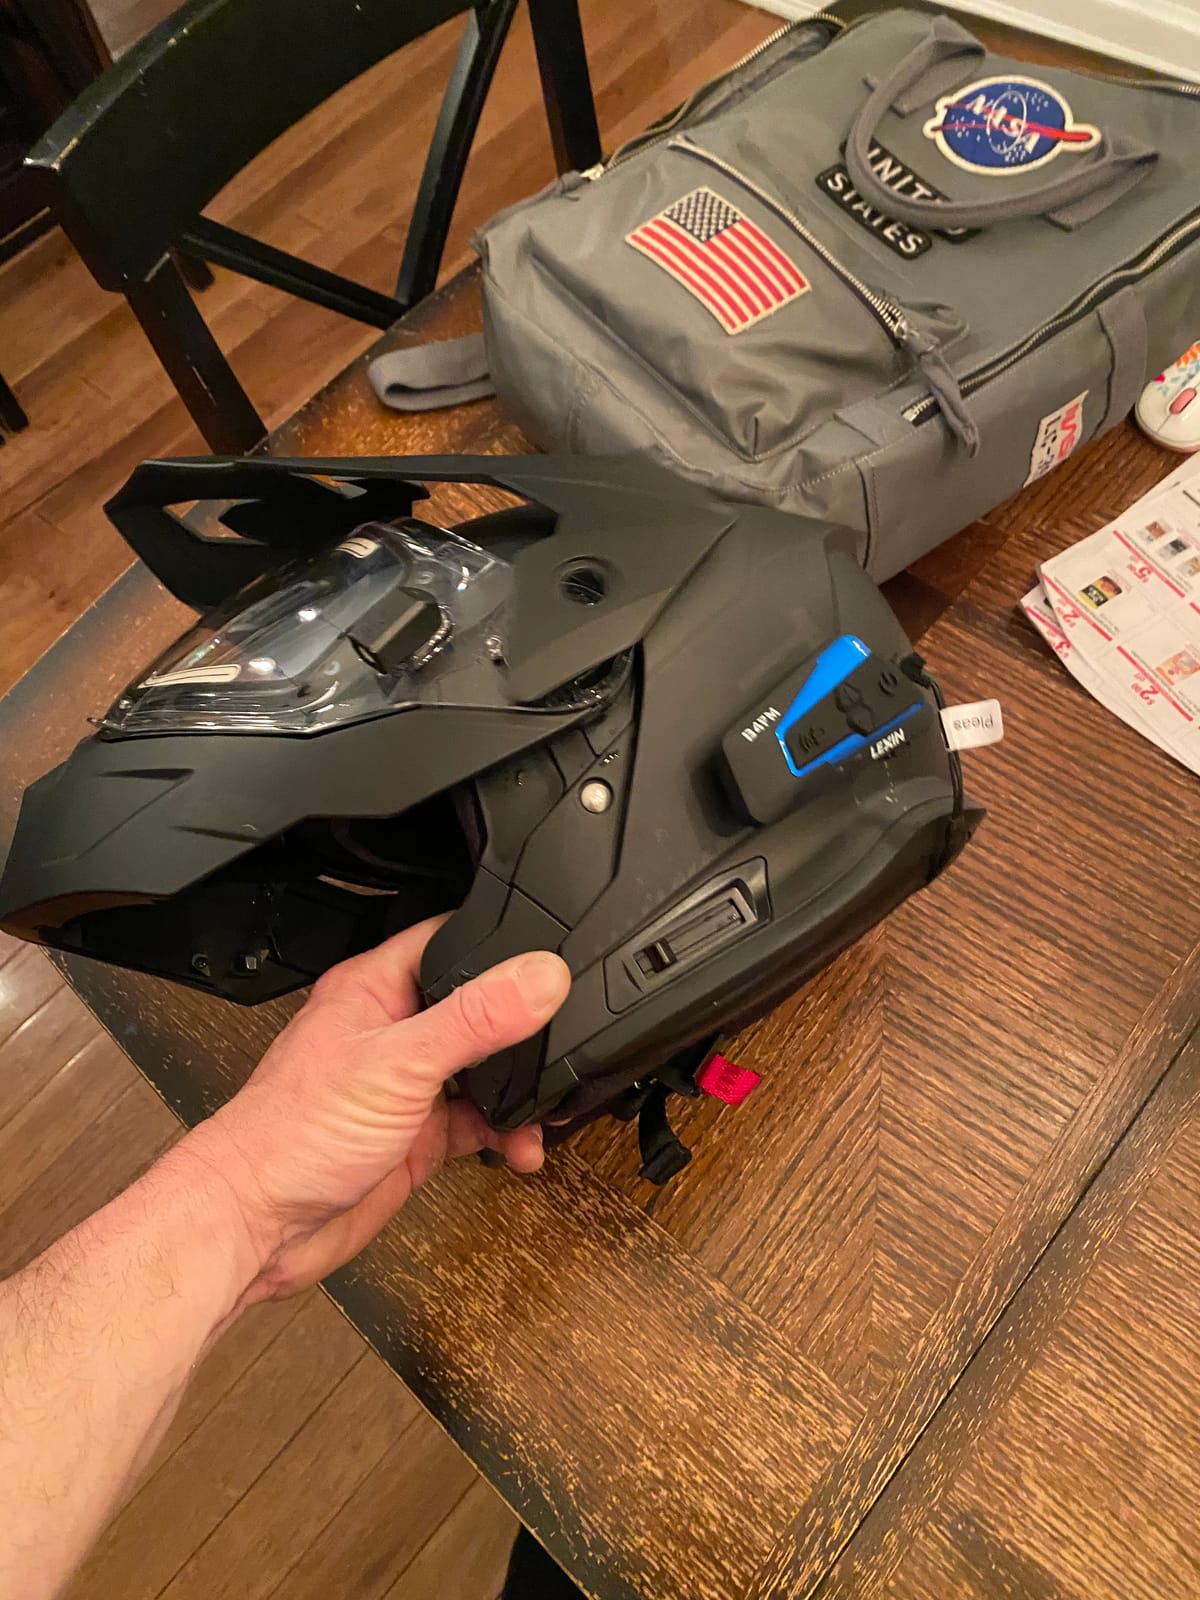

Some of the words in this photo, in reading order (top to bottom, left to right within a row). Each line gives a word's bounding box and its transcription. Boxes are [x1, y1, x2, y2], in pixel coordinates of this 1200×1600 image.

[965, 94, 1041, 154] NASA
[952, 713, 995, 733] Pleas
[869, 728, 907, 760] LEXIN
